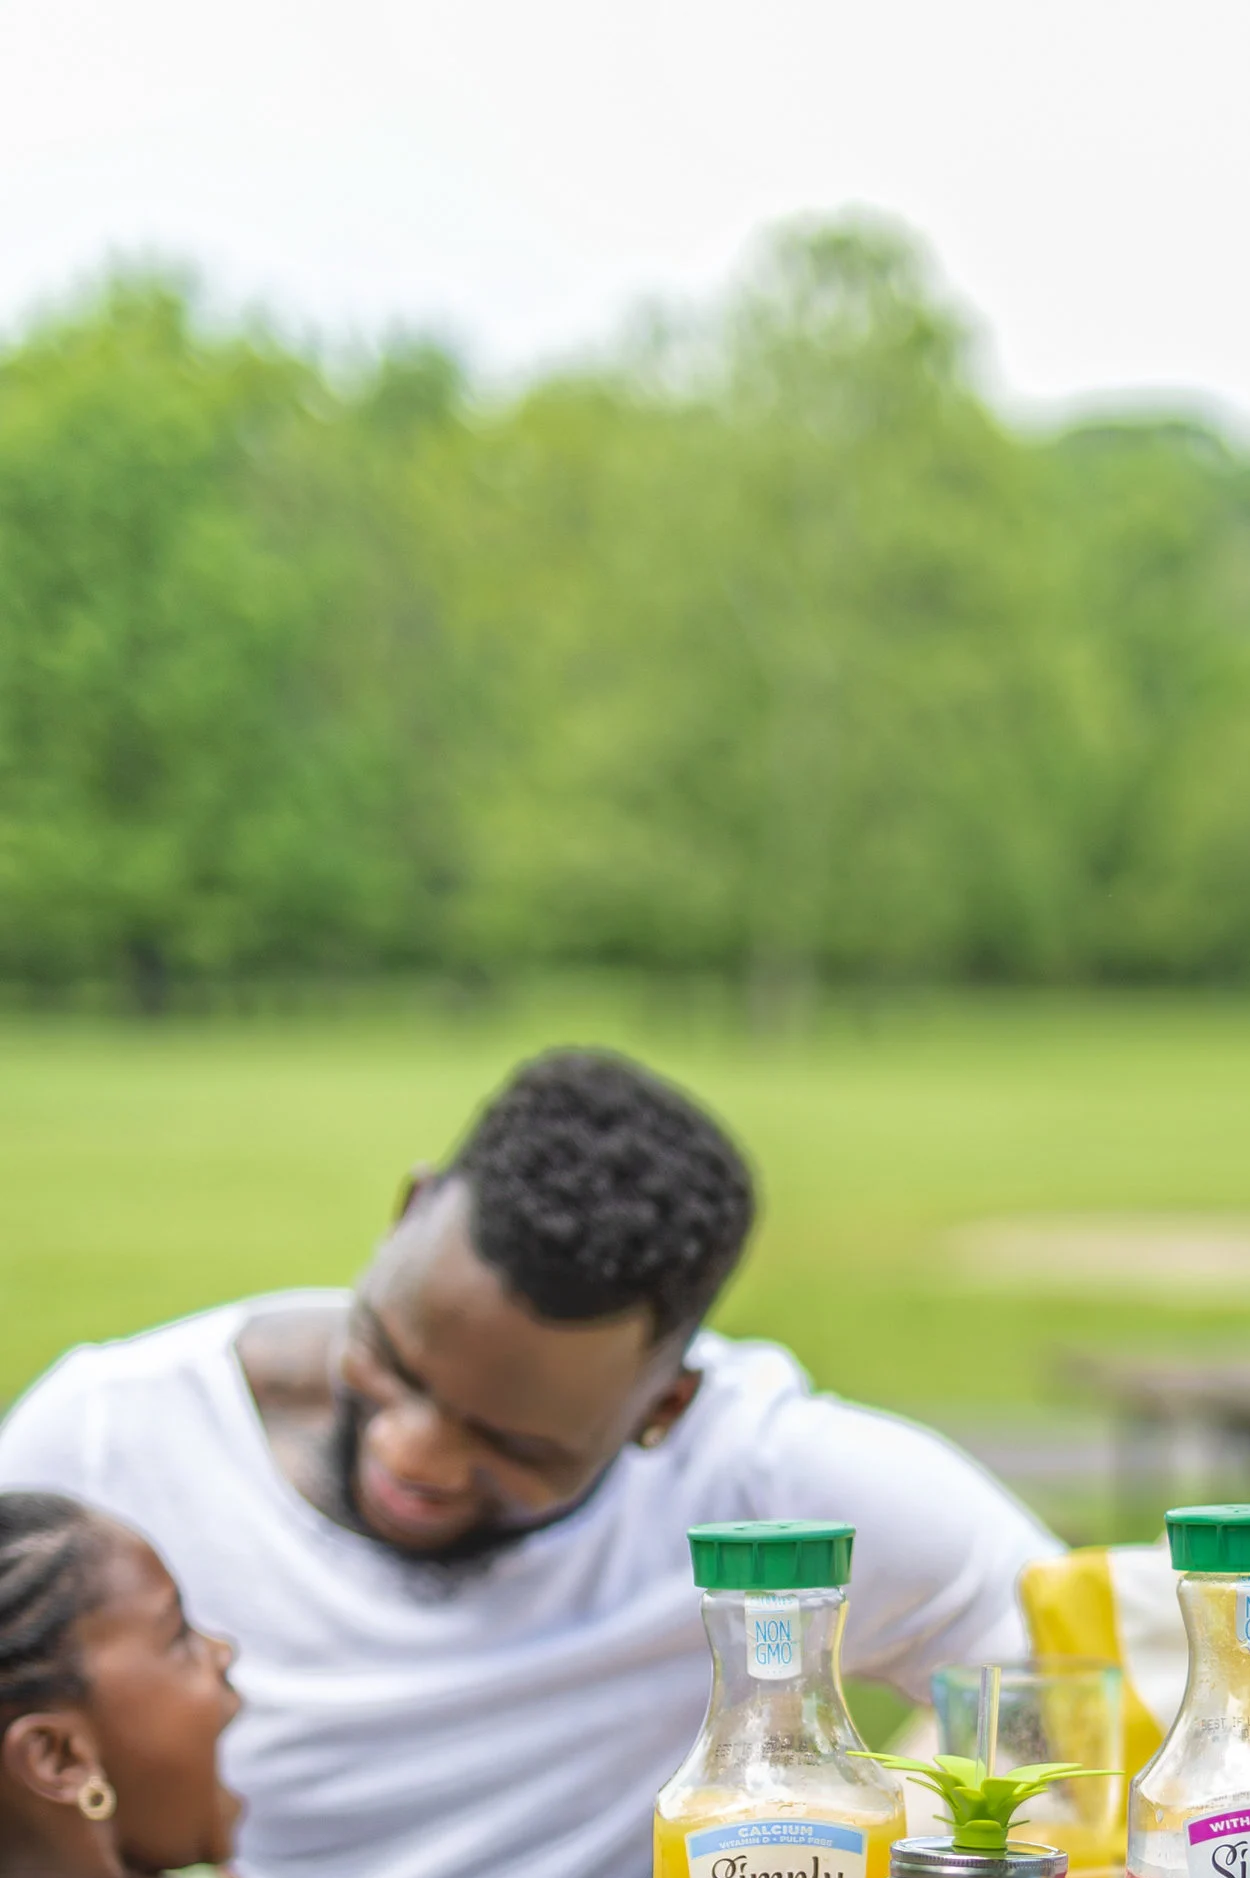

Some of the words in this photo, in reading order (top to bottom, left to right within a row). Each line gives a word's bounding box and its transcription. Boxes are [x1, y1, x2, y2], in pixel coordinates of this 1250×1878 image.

[755, 1620, 792, 1642] NON
[755, 1642, 792, 1665] GMO
[738, 1824, 814, 1837] CALCIUM
[1209, 1816, 1250, 1832] WITH
[719, 1837, 760, 1849] VITAMIN
